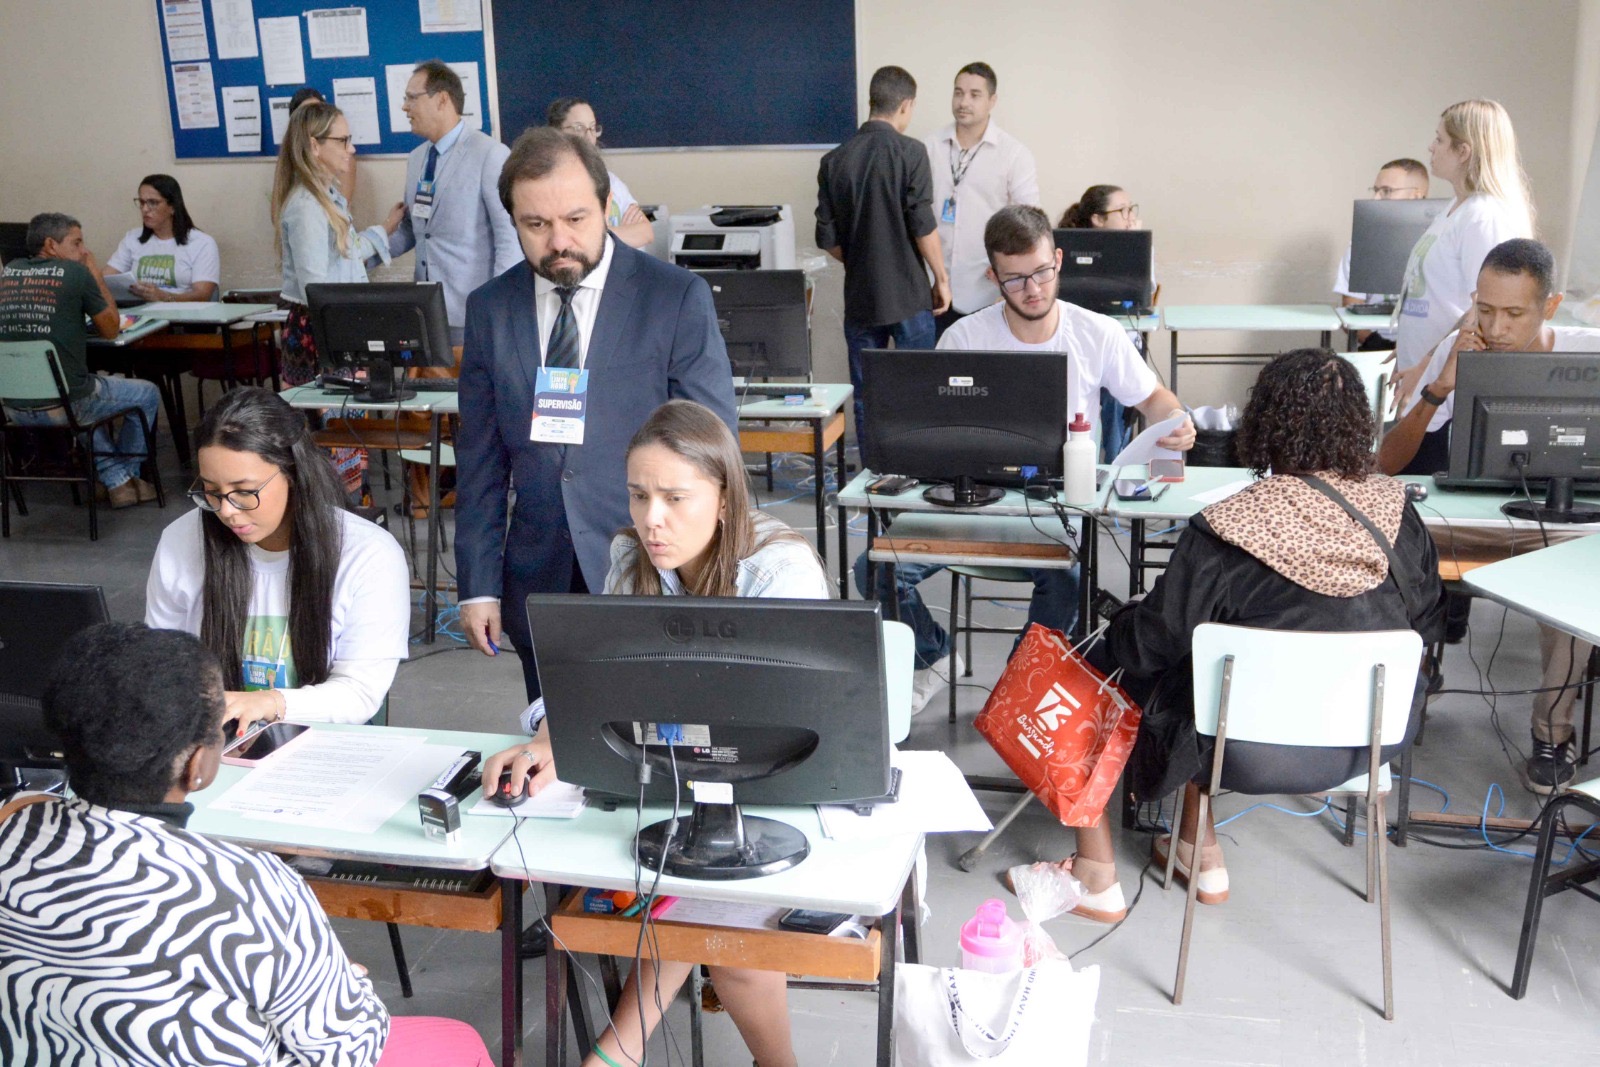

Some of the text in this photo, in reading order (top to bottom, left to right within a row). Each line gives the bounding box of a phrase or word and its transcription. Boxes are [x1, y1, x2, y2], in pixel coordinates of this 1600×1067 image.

[140, 265, 172, 279] LIMPA
[937, 385, 989, 397] PHILIPS
[538, 399, 582, 411] SUPERVISÃO
[703, 620, 737, 638] LG
[248, 627, 291, 658] RÃO
[1017, 714, 1055, 758] Burgundy
